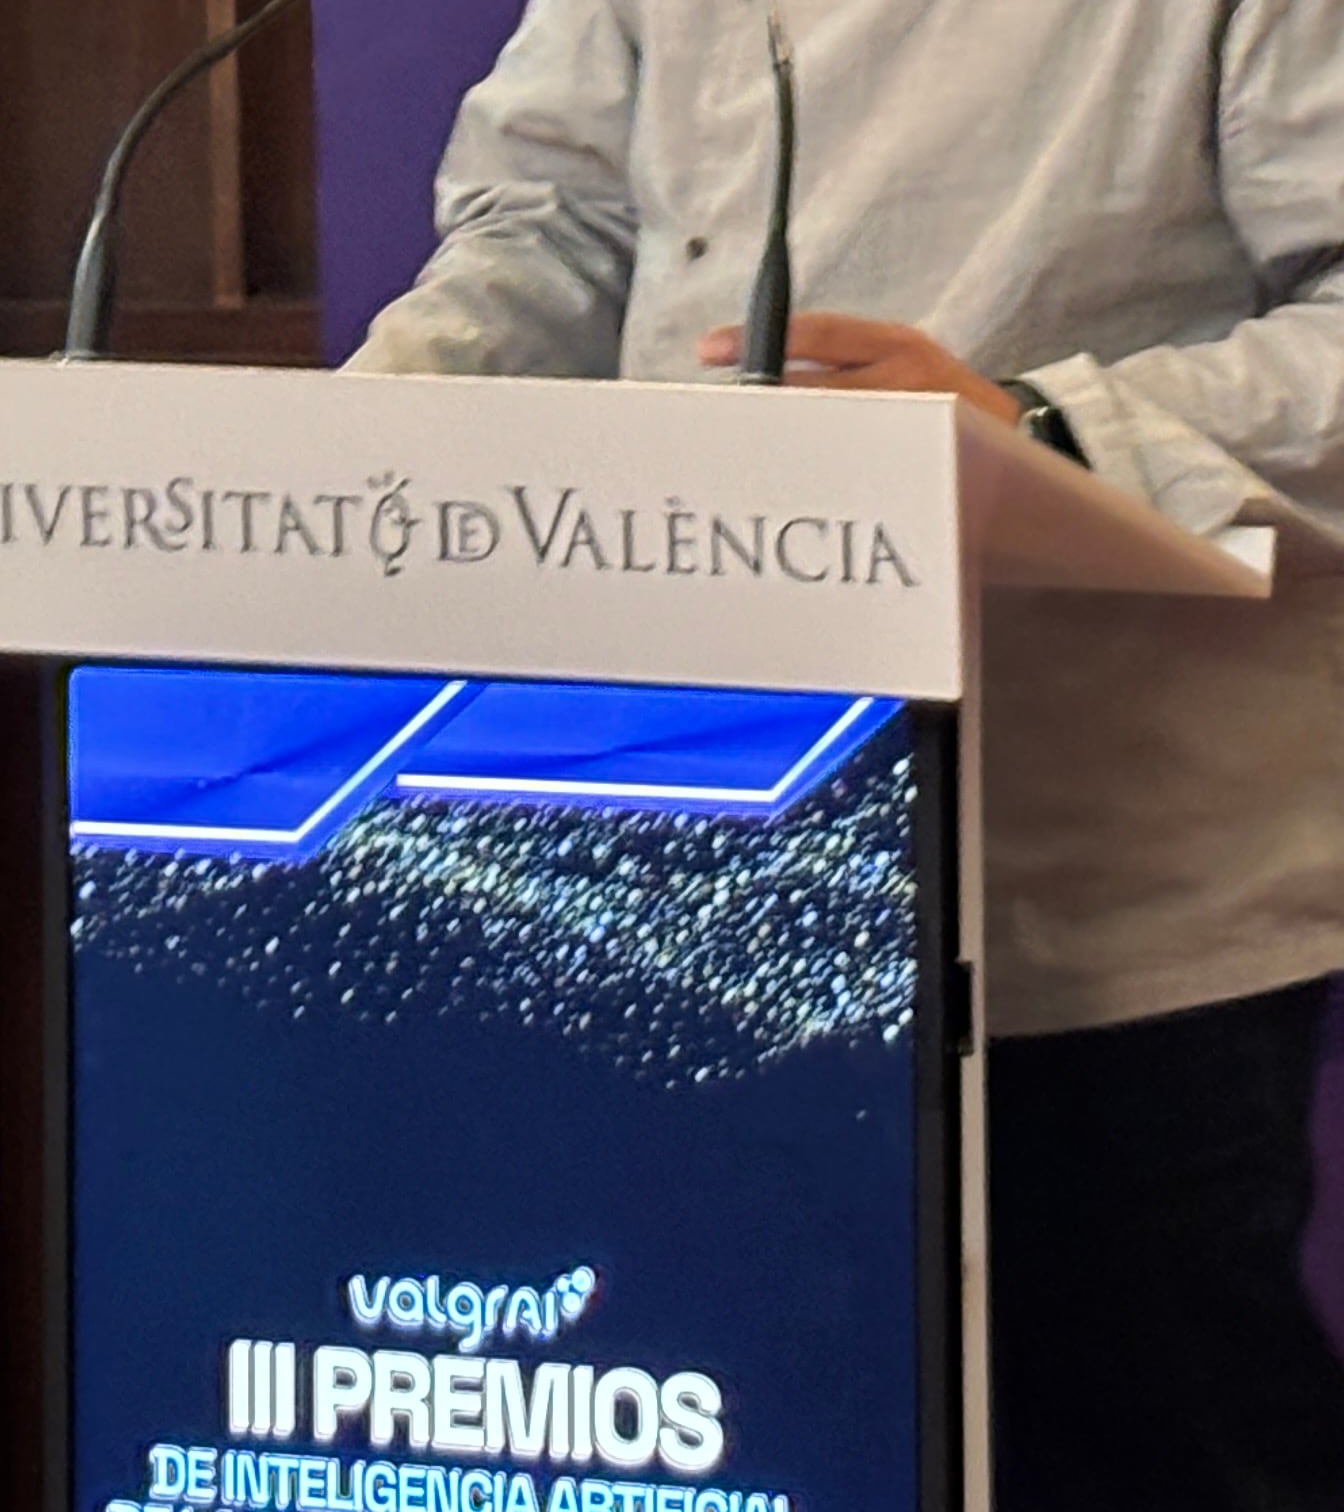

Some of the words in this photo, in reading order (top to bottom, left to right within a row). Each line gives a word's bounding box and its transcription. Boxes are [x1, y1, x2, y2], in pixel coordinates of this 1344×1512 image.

[228, 1339, 296, 1435] III
[312, 1345, 725, 1466] PREMIOS
[149, 1443, 218, 1502] DE
[221, 1450, 540, 1512] INTELIGENCIA
